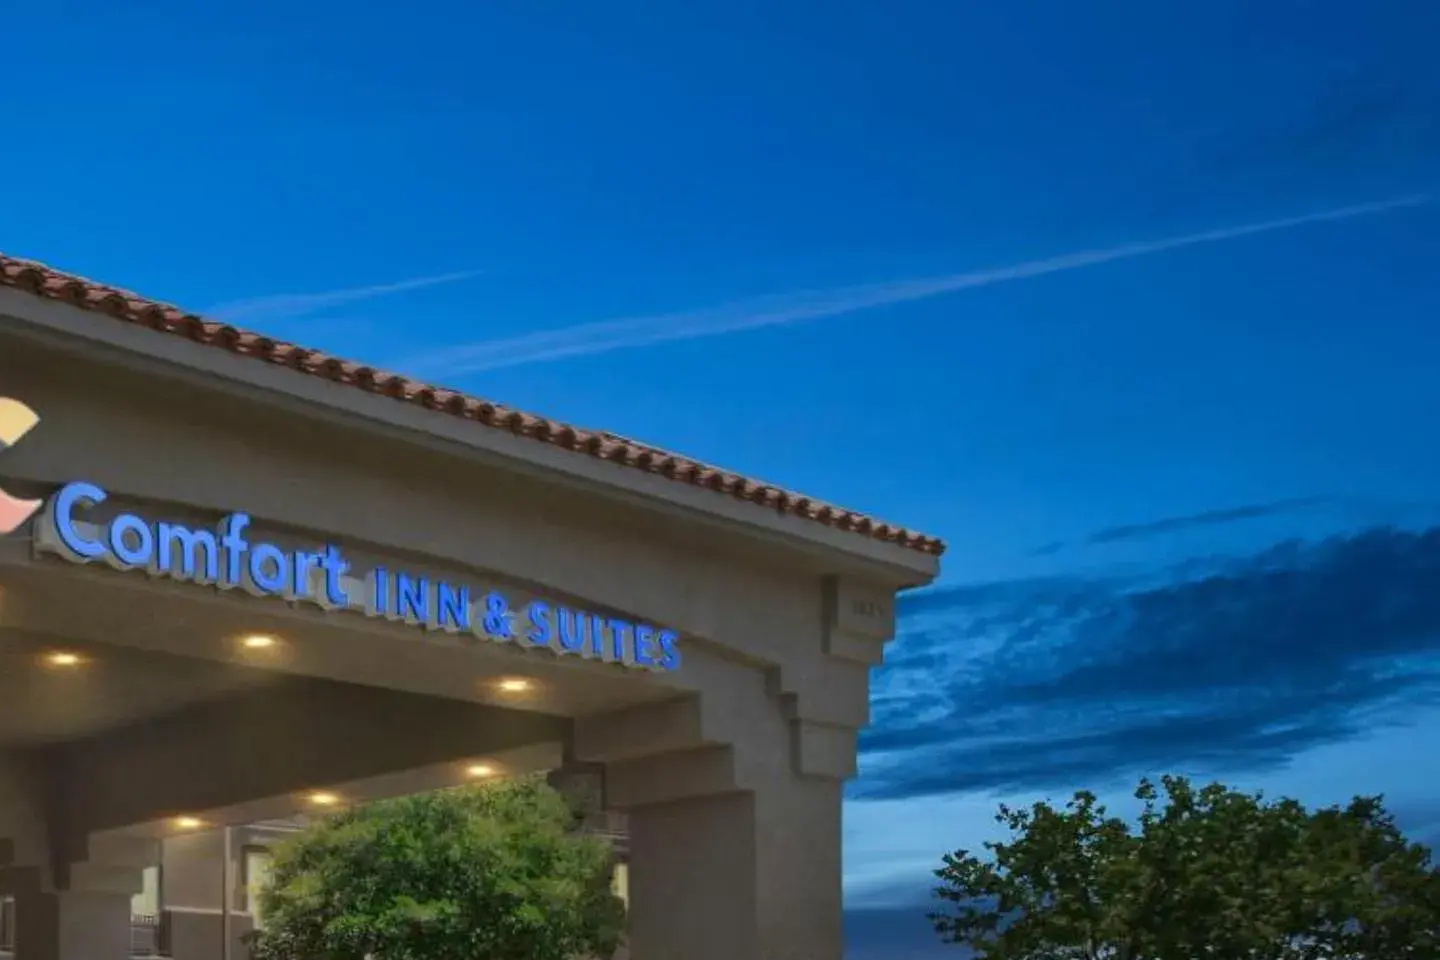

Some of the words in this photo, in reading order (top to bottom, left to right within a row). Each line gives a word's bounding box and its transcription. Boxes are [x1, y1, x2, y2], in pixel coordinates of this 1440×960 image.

[52, 481, 351, 607] Comfort
[373, 567, 471, 631] INN
[482, 590, 516, 640] &
[526, 600, 682, 673] SUITES
